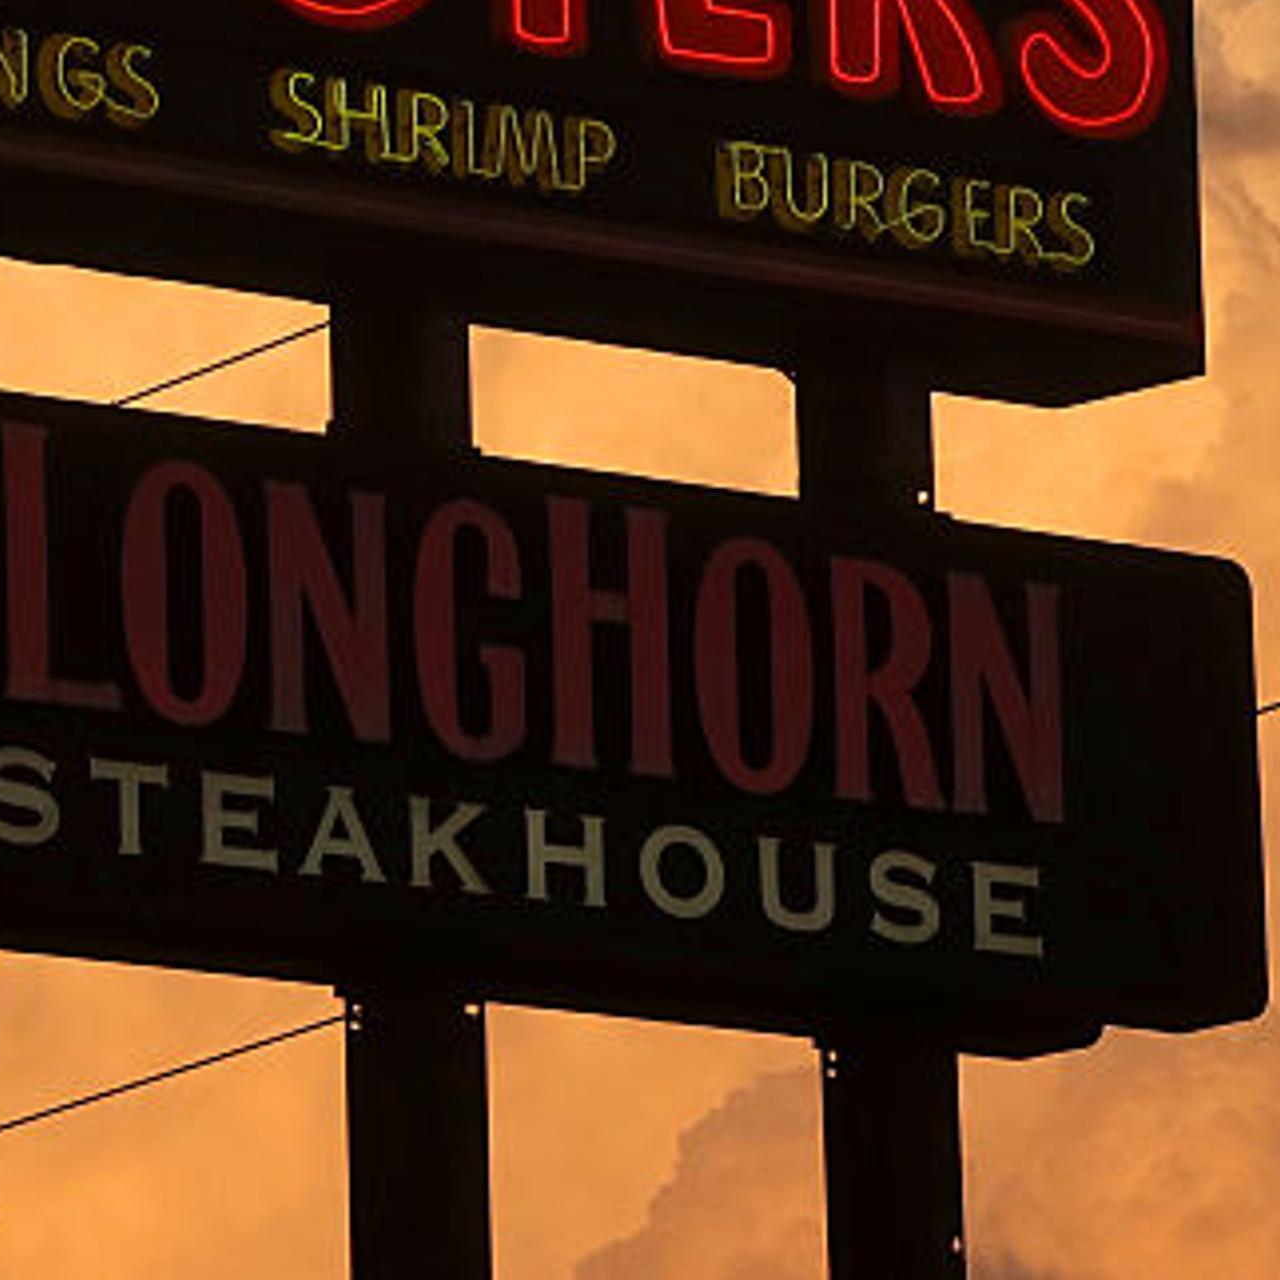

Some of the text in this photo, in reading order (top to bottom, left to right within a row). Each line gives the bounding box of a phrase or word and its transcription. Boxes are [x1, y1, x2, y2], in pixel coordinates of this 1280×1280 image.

[270, 70, 618, 193] SHRIMP
[718, 140, 1098, 267] BURGERS
[2, 421, 1064, 824] LONGHORN
